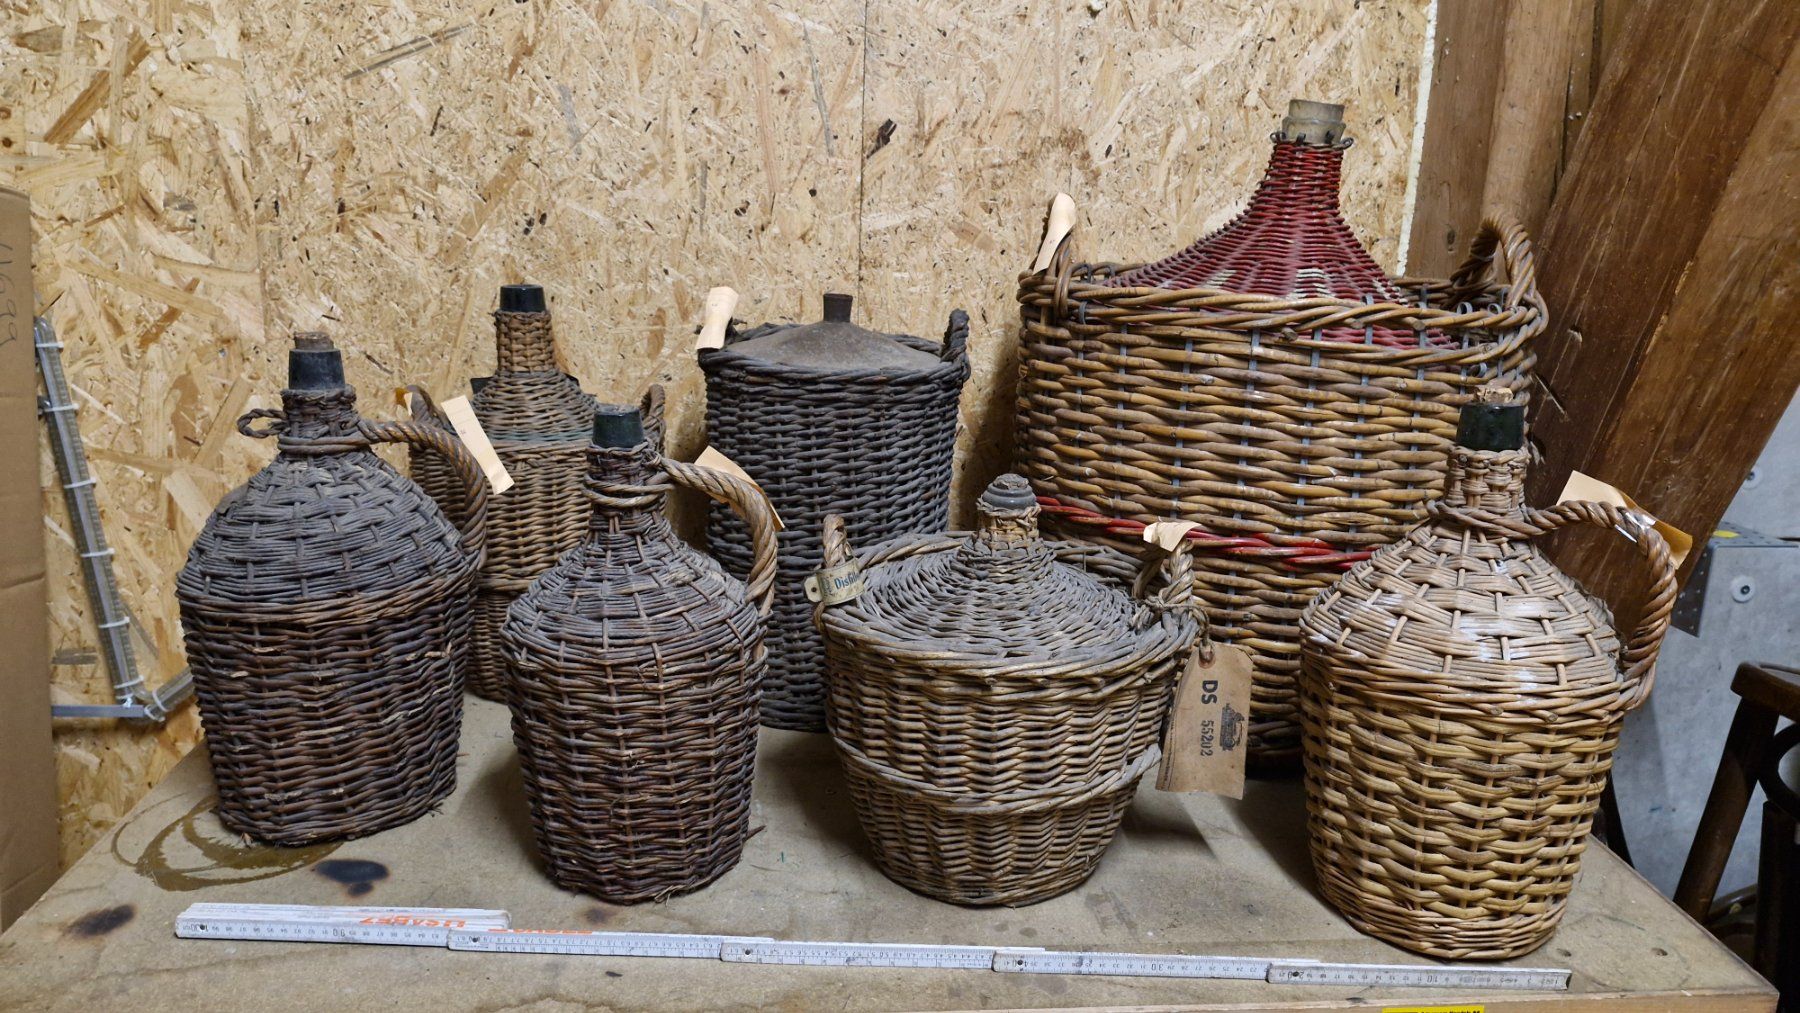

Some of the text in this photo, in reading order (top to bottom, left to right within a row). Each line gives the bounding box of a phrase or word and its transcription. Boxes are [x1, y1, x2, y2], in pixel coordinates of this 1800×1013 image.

[1200, 680, 1218, 757] DS 55202
[333, 928, 345, 937] 90
[1151, 963, 1163, 971] 30
[1427, 975, 1438, 983] 10
